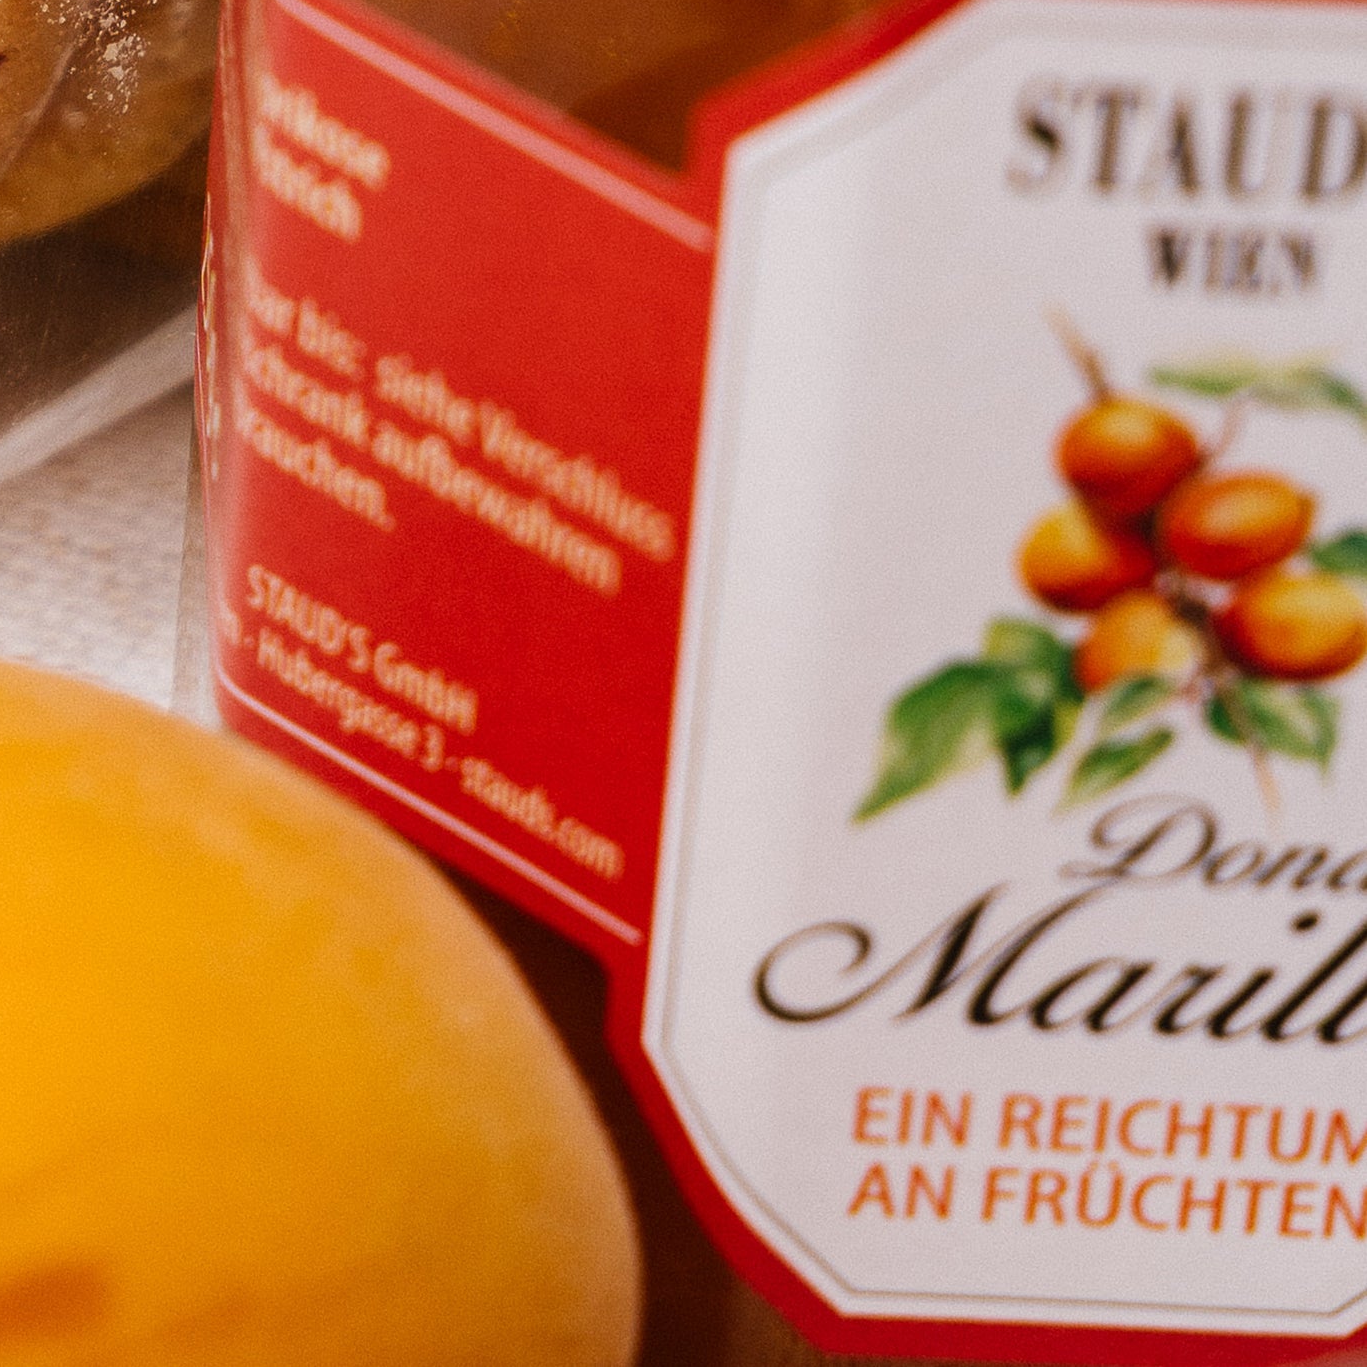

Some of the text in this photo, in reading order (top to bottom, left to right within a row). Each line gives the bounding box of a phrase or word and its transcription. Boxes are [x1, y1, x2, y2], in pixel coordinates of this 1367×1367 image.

[1005, 75, 1367, 209] STAUD
[247, 563, 478, 735] STAUD'S GmbH
[256, 627, 421, 760] Hubergasse
[851, 1085, 1367, 1169] EIN REICHTUM
[847, 1160, 1367, 1244] AN FRÜCHTEN
